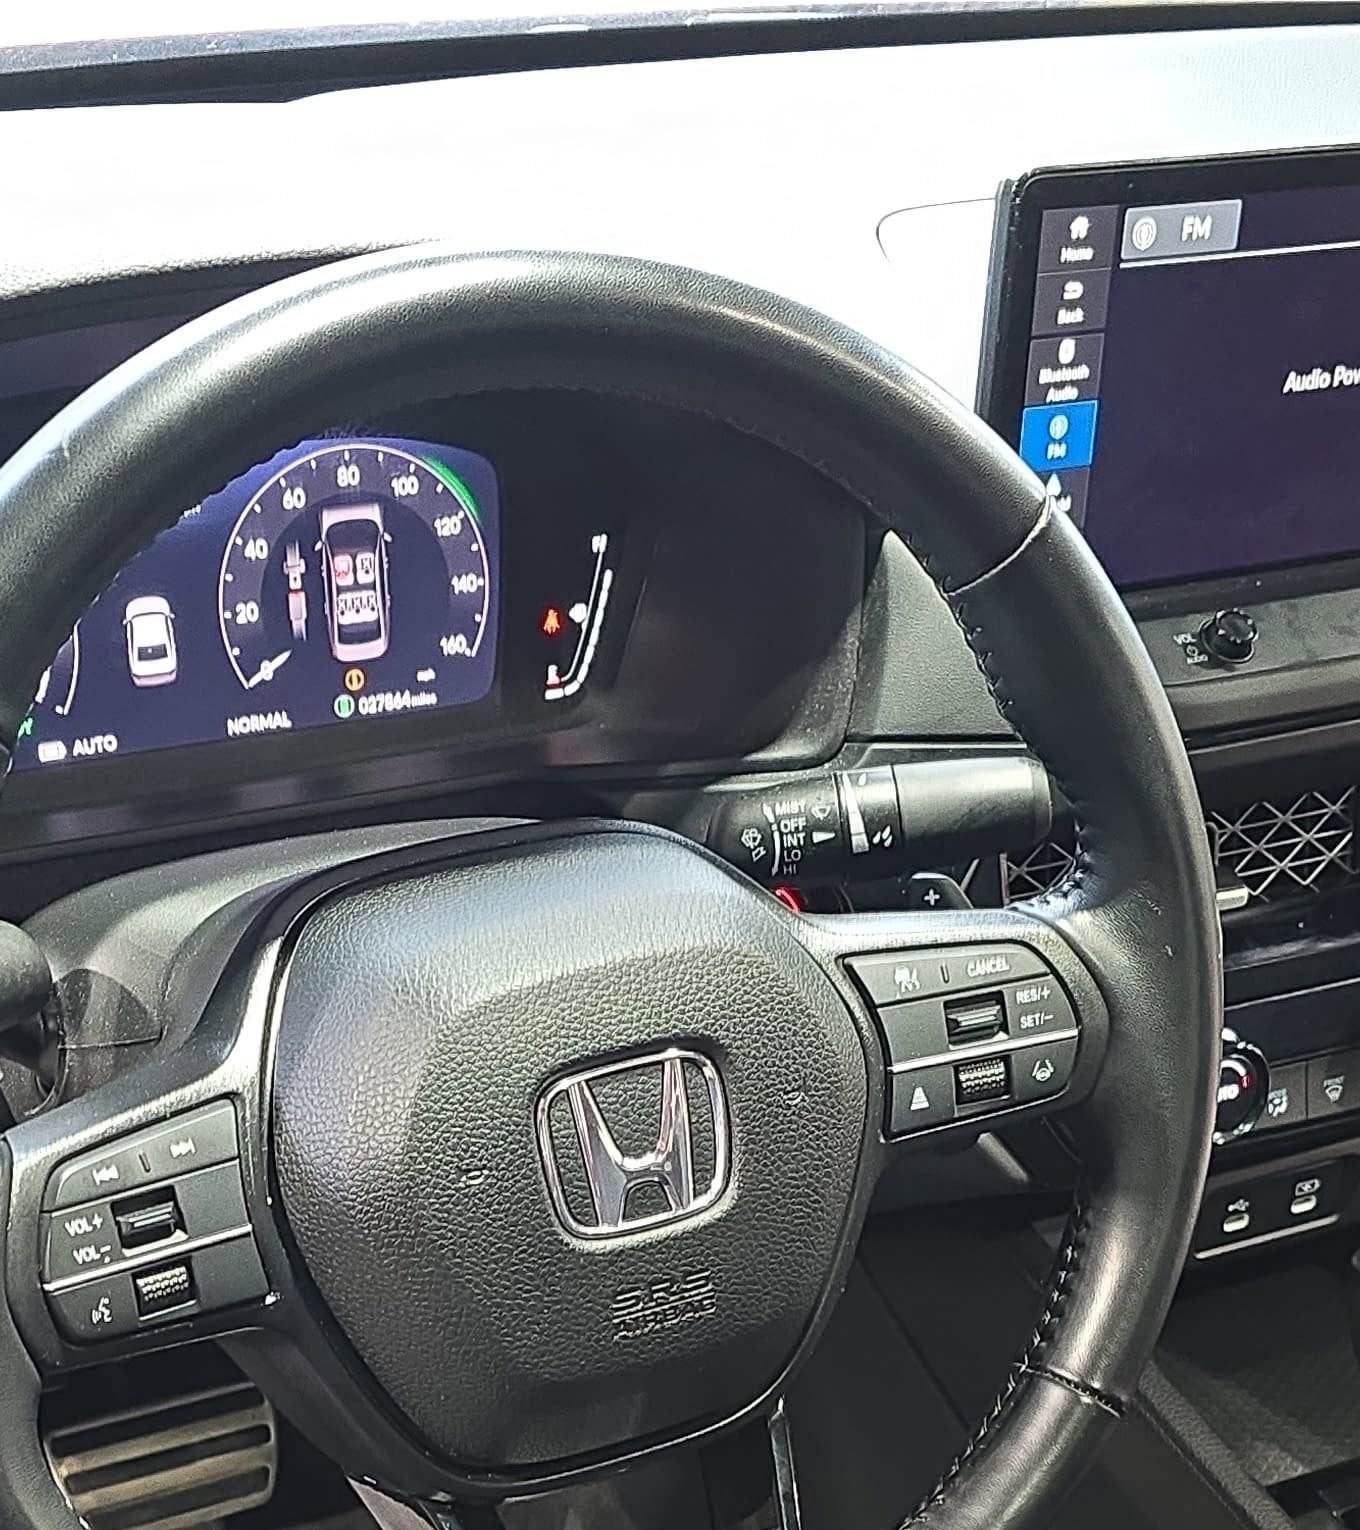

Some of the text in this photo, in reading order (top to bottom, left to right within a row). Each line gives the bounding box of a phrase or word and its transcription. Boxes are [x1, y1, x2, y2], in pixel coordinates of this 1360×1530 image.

[1181, 215, 1213, 242] FM
[1060, 246, 1094, 264] Home
[1282, 367, 1331, 394] Audio
[337, 464, 360, 486] 80
[391, 475, 419, 498] 100
[282, 487, 306, 510] 60
[433, 515, 461, 538] 120
[244, 538, 269, 561] 40
[451, 573, 478, 595] 140
[235, 601, 260, 624] 20
[440, 634, 467, 656] 160
[1173, 633, 1197, 645] VOL
[226, 711, 293, 737] NORMAL
[72, 734, 118, 758] AUTO
[775, 800, 806, 816] MIST
[780, 817, 807, 833] OFF
[782, 832, 806, 848] INT
[783, 849, 801, 862] LO
[782, 864, 797, 875] HI
[966, 956, 1010, 978] CANCEL
